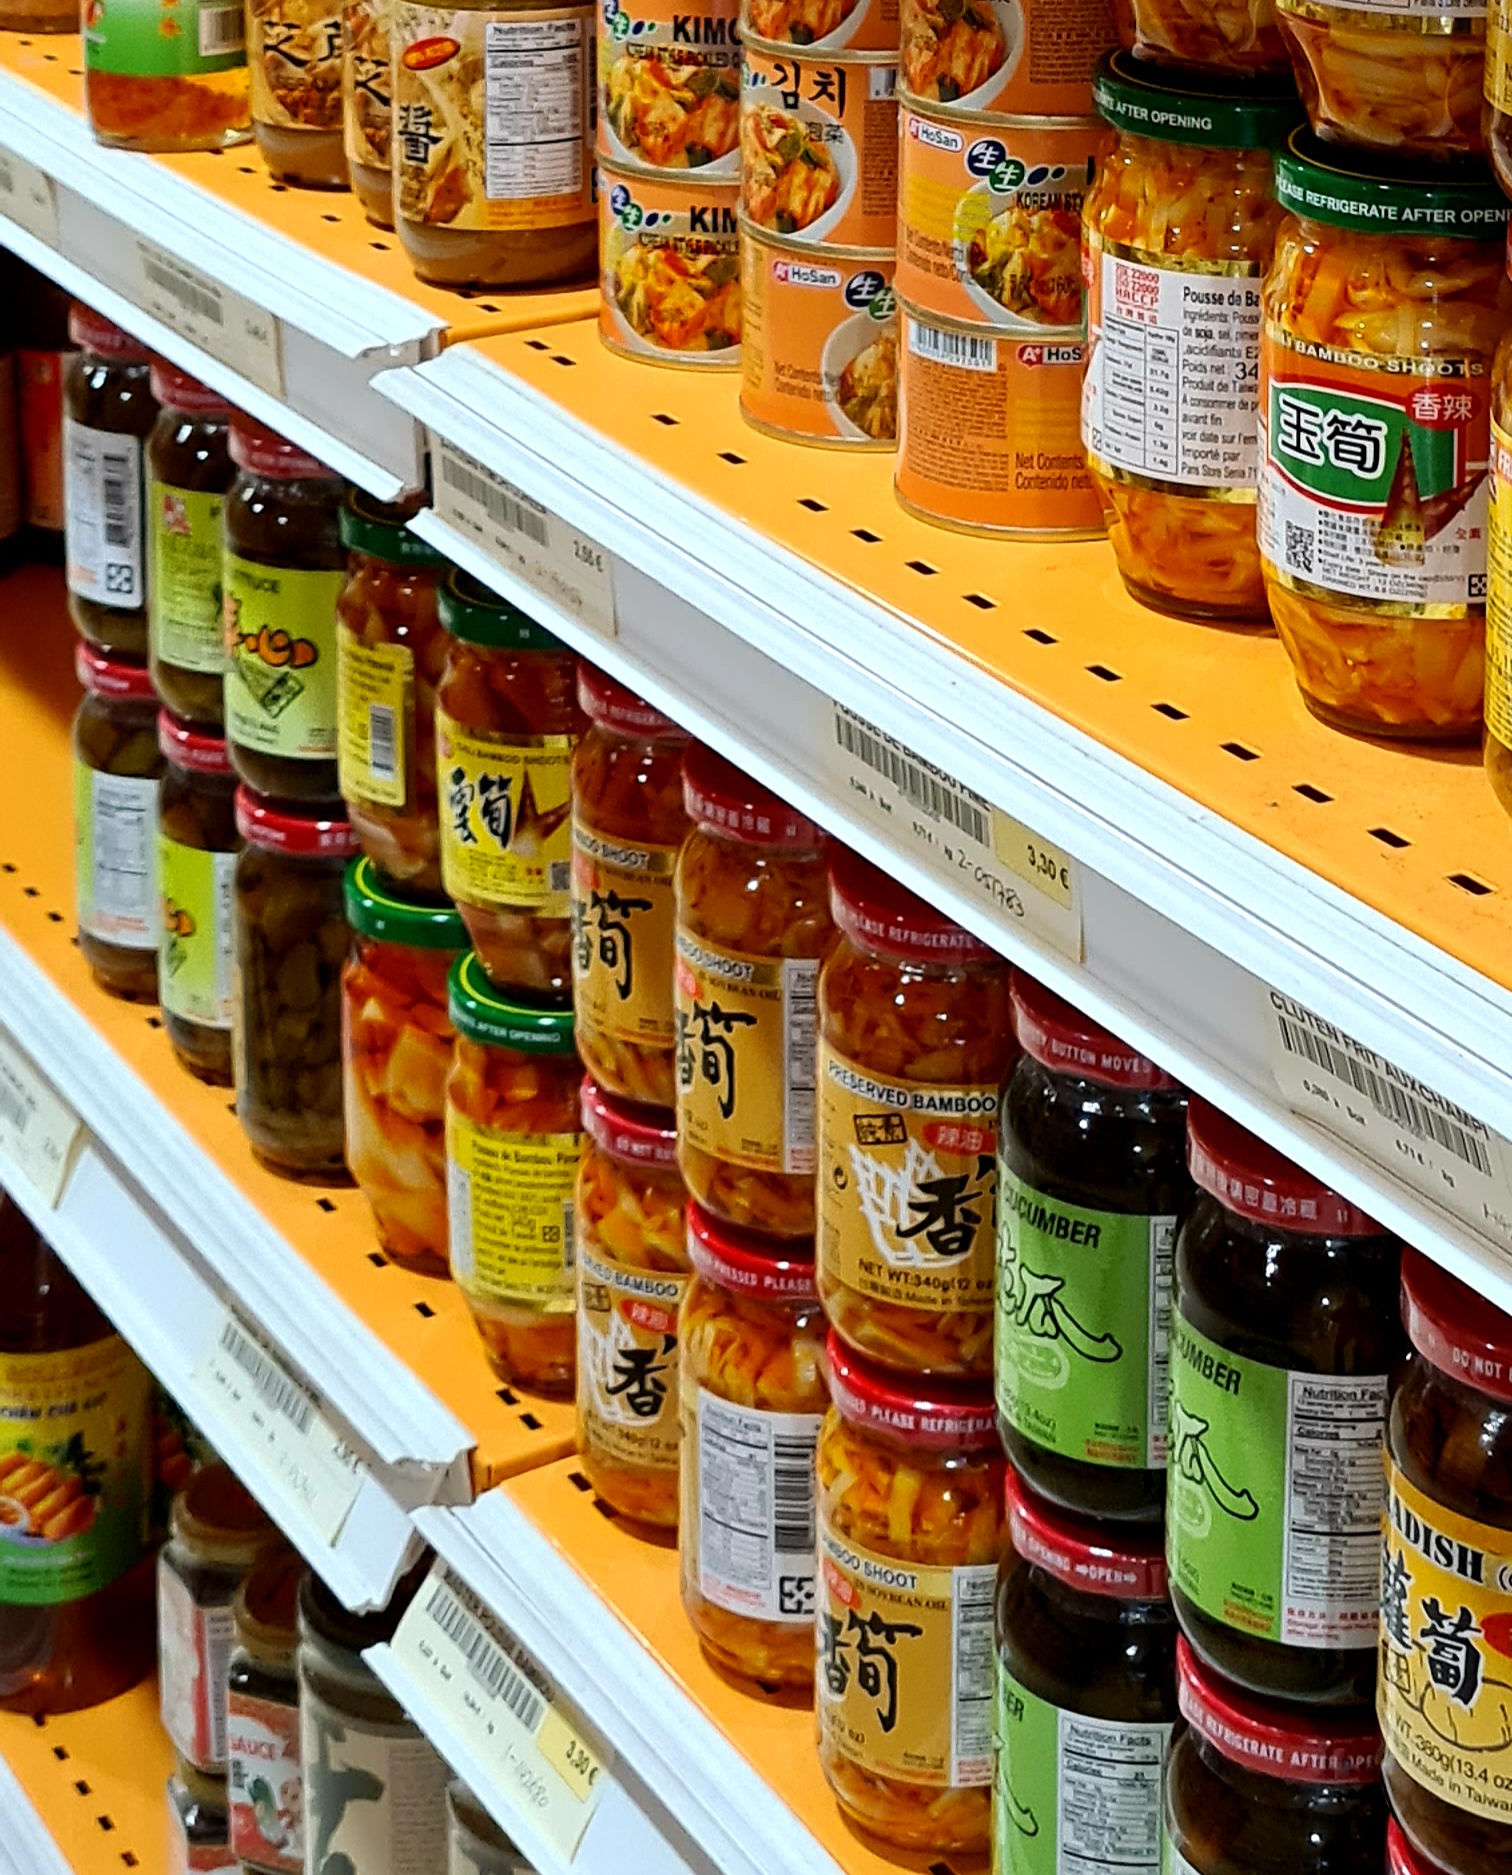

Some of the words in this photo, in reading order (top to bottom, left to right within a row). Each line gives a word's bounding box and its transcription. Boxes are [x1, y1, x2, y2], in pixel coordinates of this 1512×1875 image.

[769, 60, 847, 120] 김치
[1115, 102, 1149, 123] AFTER
[1150, 110, 1213, 131] OPENING
[919, 123, 959, 151] HoSan
[1305, 189, 1399, 221] REFRIGERATE
[1401, 206, 1458, 224] AFTER
[789, 263, 838, 287] HoSan
[1183, 286, 1224, 305] Pousse
[1227, 291, 1242, 306] de
[1295, 342, 1380, 370] BAMBOO
[1386, 358, 1484, 376] SHOOTS
[1412, 392, 1473, 421] 香辣
[1280, 396, 1384, 475] 玉筍
[1015, 450, 1034, 470] Net
[1015, 471, 1069, 492] Contenido
[1051, 1040, 1097, 1066] BUTTON
[827, 1061, 908, 1107] PRESERVED
[912, 1091, 997, 1113] BAMBOO
[1474, 1357, 1502, 1380] NOT
[1394, 1494, 1484, 1584] ADISH
[864, 1562, 917, 1589] SHOOT
[1290, 1751, 1338, 1770] AFTER
[1409, 1753, 1444, 1789] Made
[1449, 1776, 1462, 1794] in
